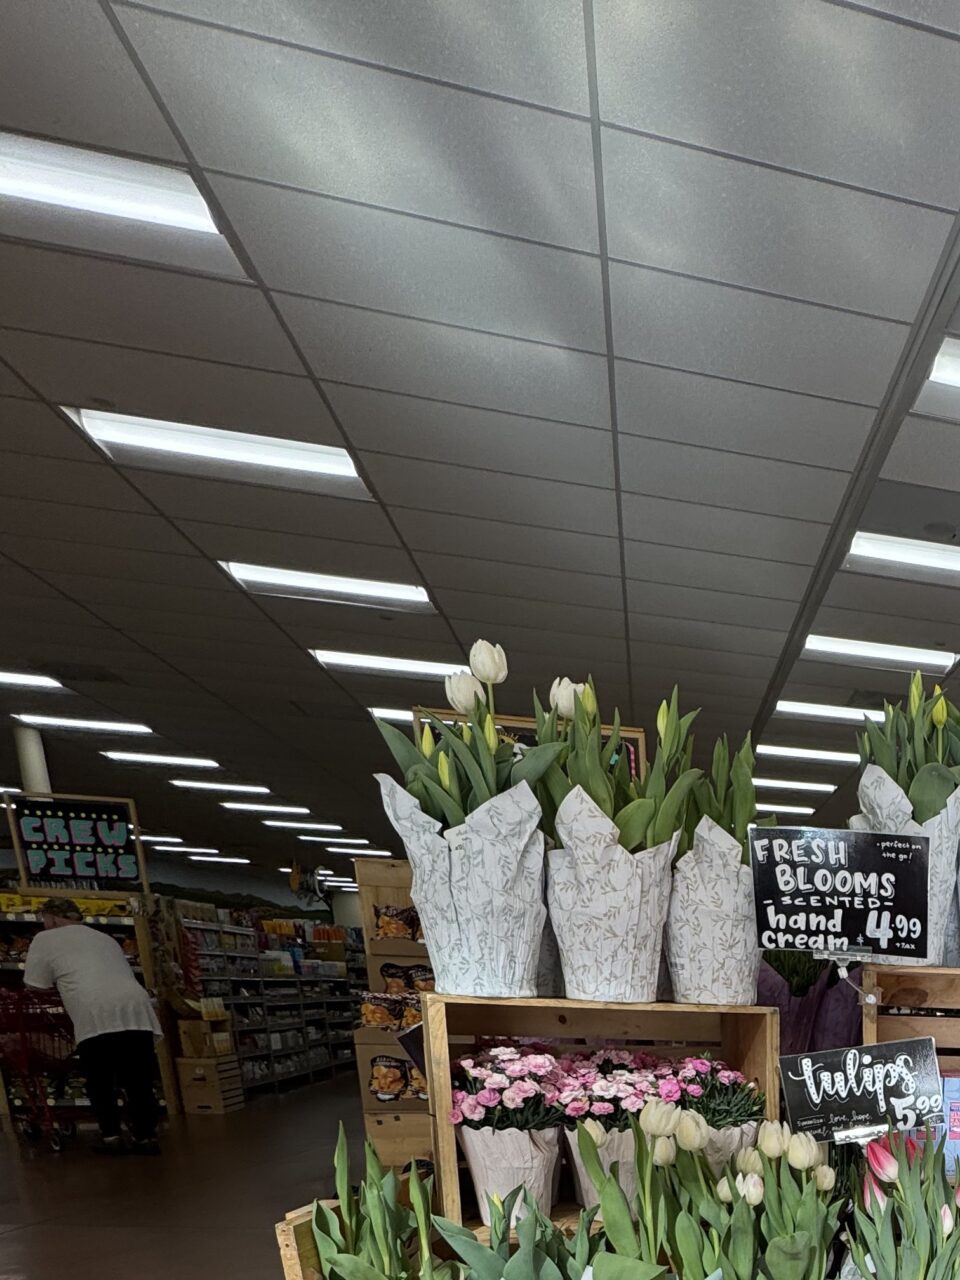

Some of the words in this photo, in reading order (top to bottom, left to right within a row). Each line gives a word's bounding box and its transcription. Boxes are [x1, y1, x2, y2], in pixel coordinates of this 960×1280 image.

[20, 817, 129, 846] CREW
[27, 849, 138, 879] PICKS
[754, 839, 848, 868] FRESH
[775, 864, 895, 899] BLOOMS
[766, 905, 843, 932] hand
[761, 930, 849, 951] cream
[788, 1049, 918, 1113] tulips
